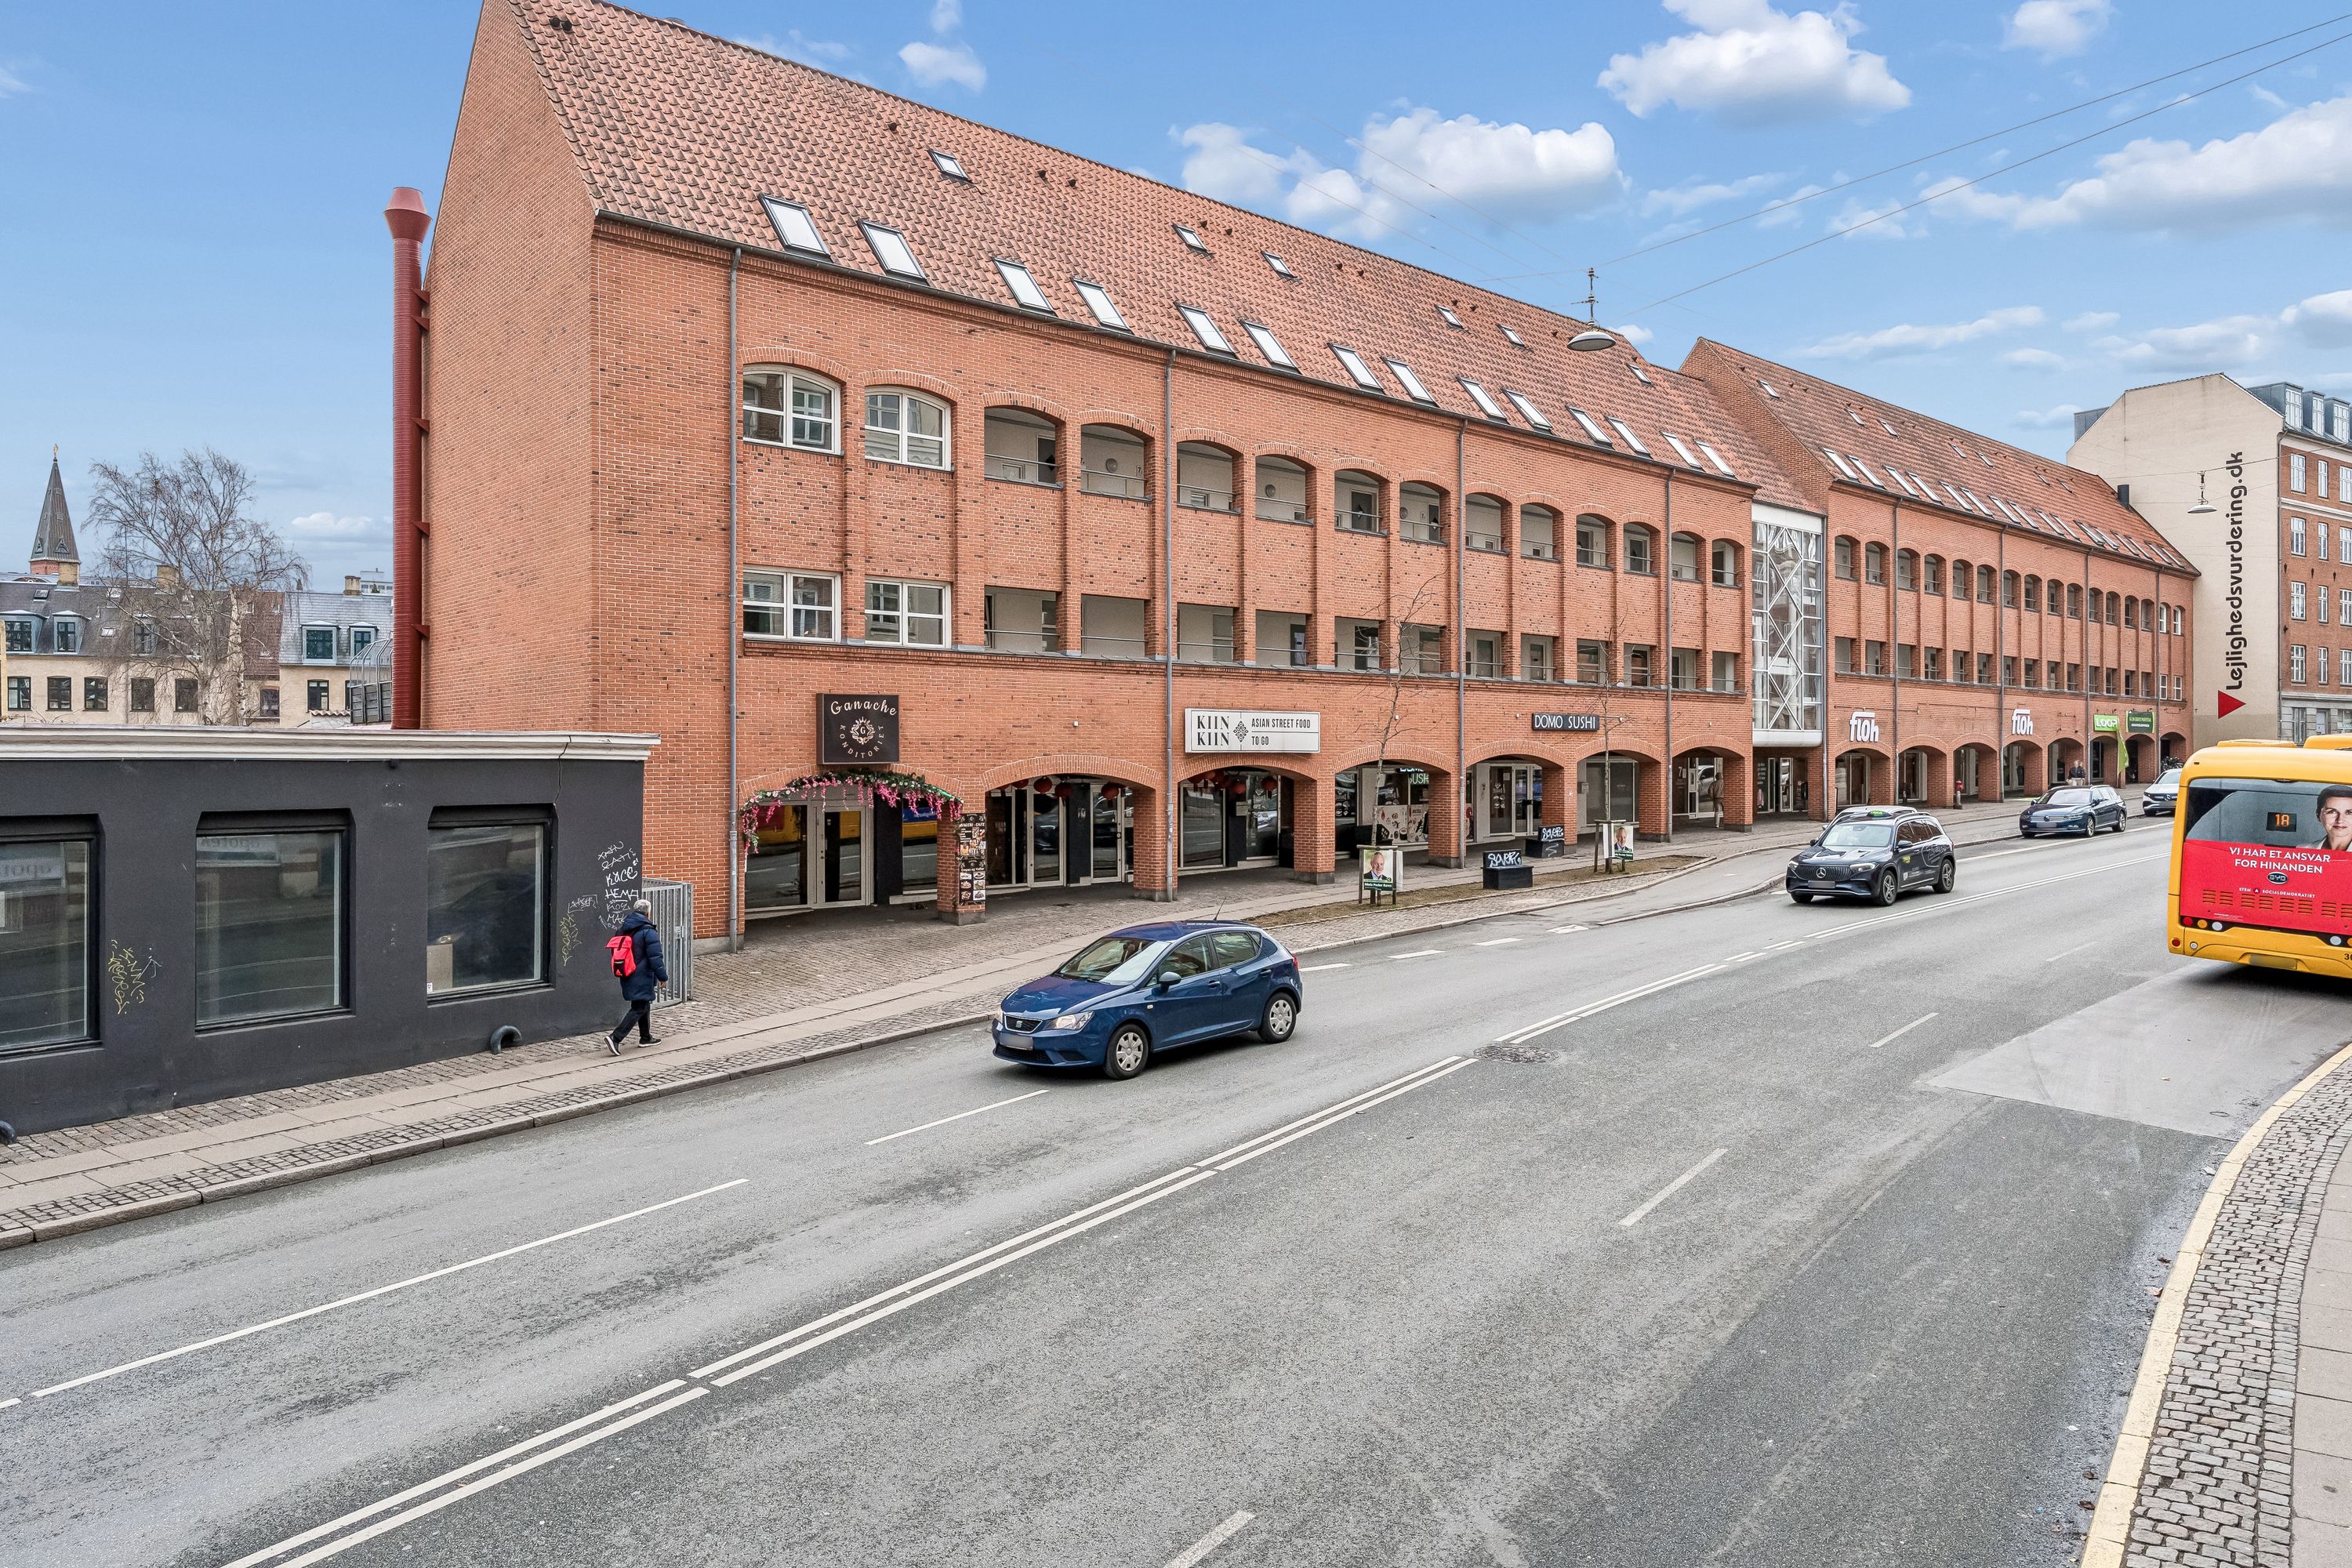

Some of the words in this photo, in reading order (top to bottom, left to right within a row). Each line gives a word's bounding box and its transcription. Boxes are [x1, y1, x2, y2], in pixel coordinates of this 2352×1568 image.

[2225, 452, 2248, 690] Lejlighedsvurdering.dk
[830, 699, 897, 716] Ganache
[1196, 715, 1230, 730] KIIN
[1251, 718, 1270, 728] ASIAN
[1272, 719, 1294, 728] STREET
[1295, 719, 1311, 728] FOOD
[1534, 714, 1563, 728] DOMO
[1568, 716, 1596, 729] SUSHI
[860, 726, 866, 735] G
[840, 724, 884, 759] KONDITORIET
[1196, 731, 1230, 746] KIIN
[1251, 735, 1259, 746] TO
[1261, 735, 1269, 746] GO
[2275, 814, 2290, 827] 18
[2230, 847, 2240, 855] VI
[2243, 848, 2267, 858] HAR
[2283, 852, 2331, 863] ANSVAR
[2234, 858, 2257, 868] FOR
[2260, 861, 2323, 874] HINANDEN
[2262, 889, 2315, 898] SOCIALDEMOKRATIET
